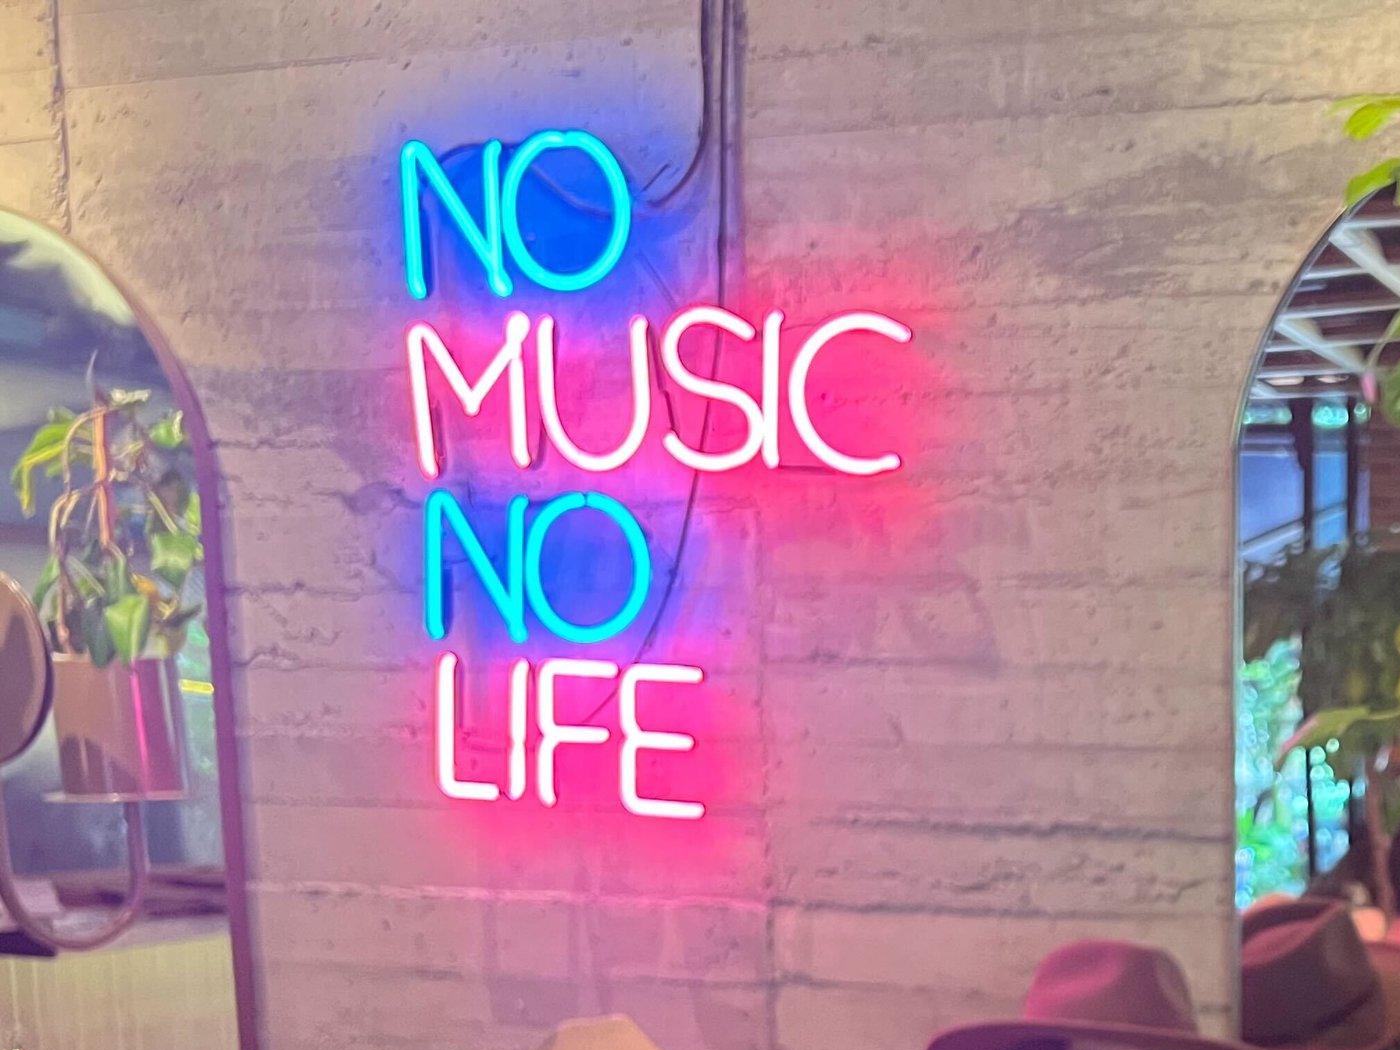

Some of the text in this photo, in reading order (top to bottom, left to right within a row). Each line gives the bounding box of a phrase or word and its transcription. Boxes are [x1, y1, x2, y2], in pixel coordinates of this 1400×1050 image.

[400, 129, 632, 299] NO
[406, 305, 911, 478] MUSIC
[424, 487, 651, 644] NO
[435, 651, 705, 819] LIFE
